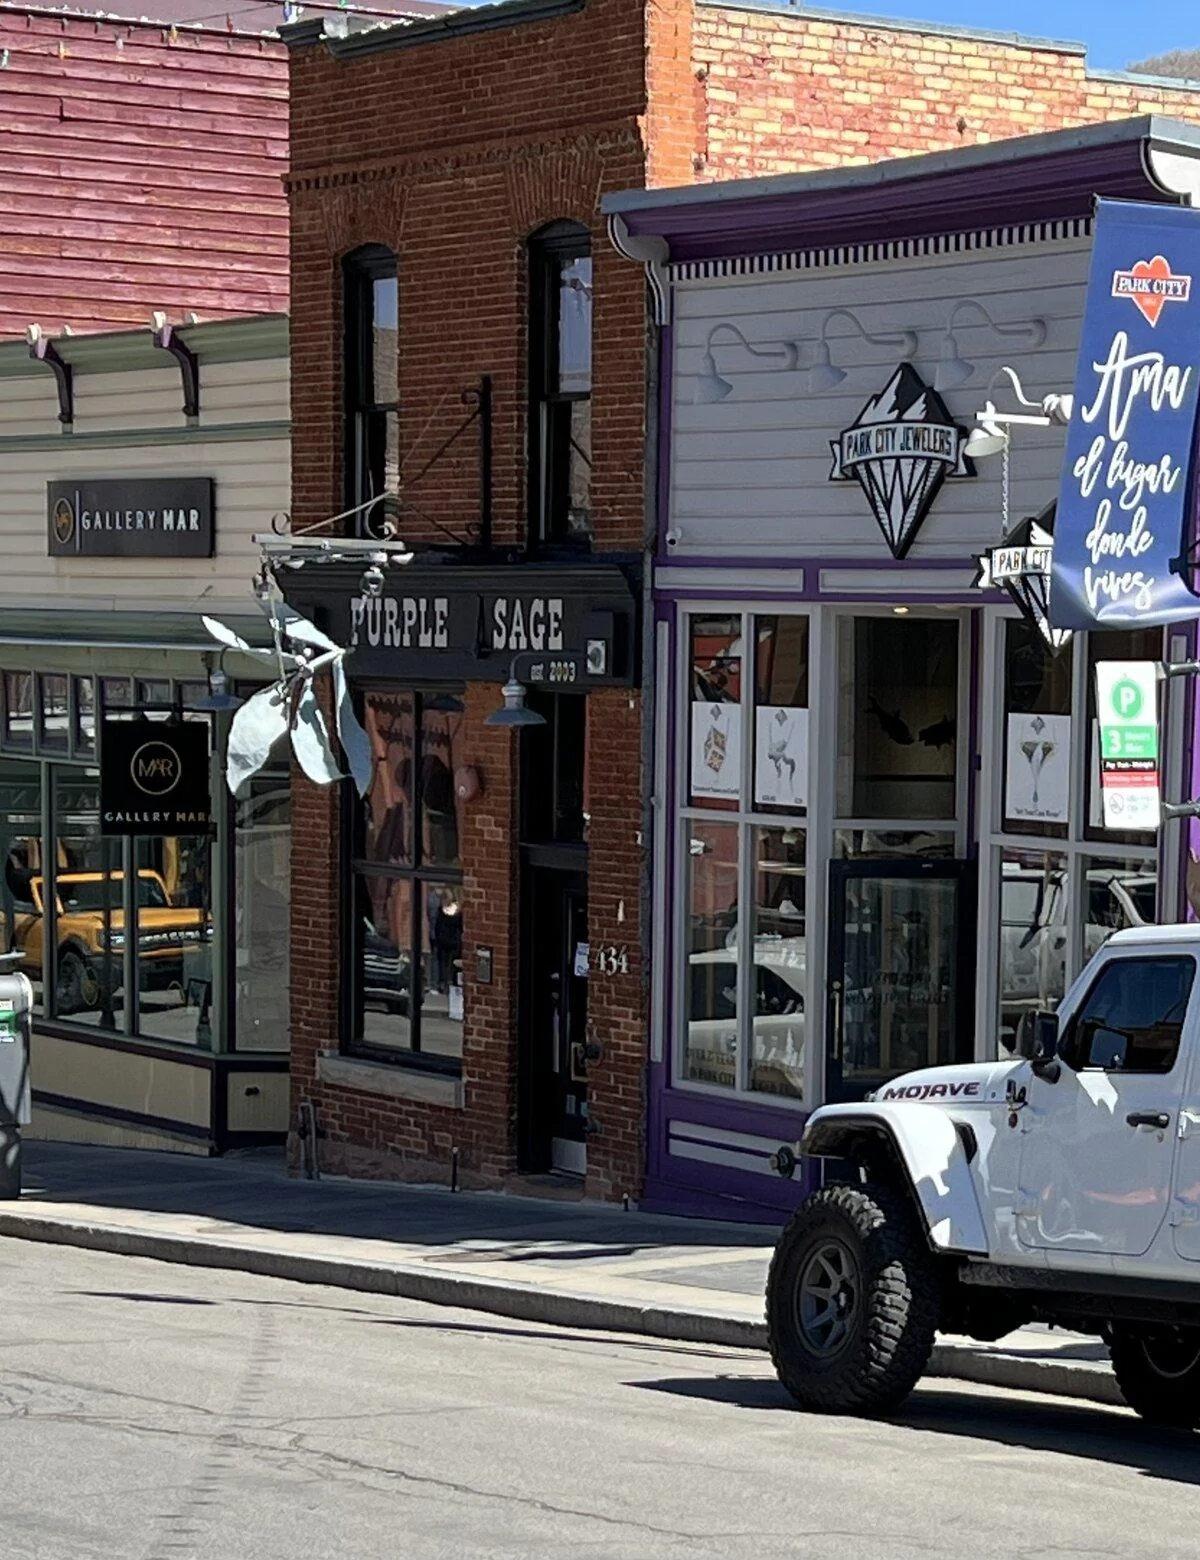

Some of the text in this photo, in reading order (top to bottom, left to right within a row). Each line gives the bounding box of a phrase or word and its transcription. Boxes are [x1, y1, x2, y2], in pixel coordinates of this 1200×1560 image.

[1118, 276, 1186, 297] PARK CITY
[1082, 331, 1192, 441] Ama
[847, 426, 952, 459] PARK CITY JEWELERS
[1073, 435, 1181, 510] el lugar
[81, 509, 156, 531] GALLERY
[163, 508, 200, 531] MAR
[1085, 499, 1154, 565] donde
[999, 551, 1028, 573] PARK
[351, 597, 563, 650] PURPLE SAGE
[549, 661, 576, 682] 2003
[1119, 685, 1137, 714] P
[1108, 729, 1123, 754] 3
[103, 811, 206, 822] GALLERY MAR
[596, 944, 628, 976] 434
[883, 1082, 980, 1100] MOJAVE
